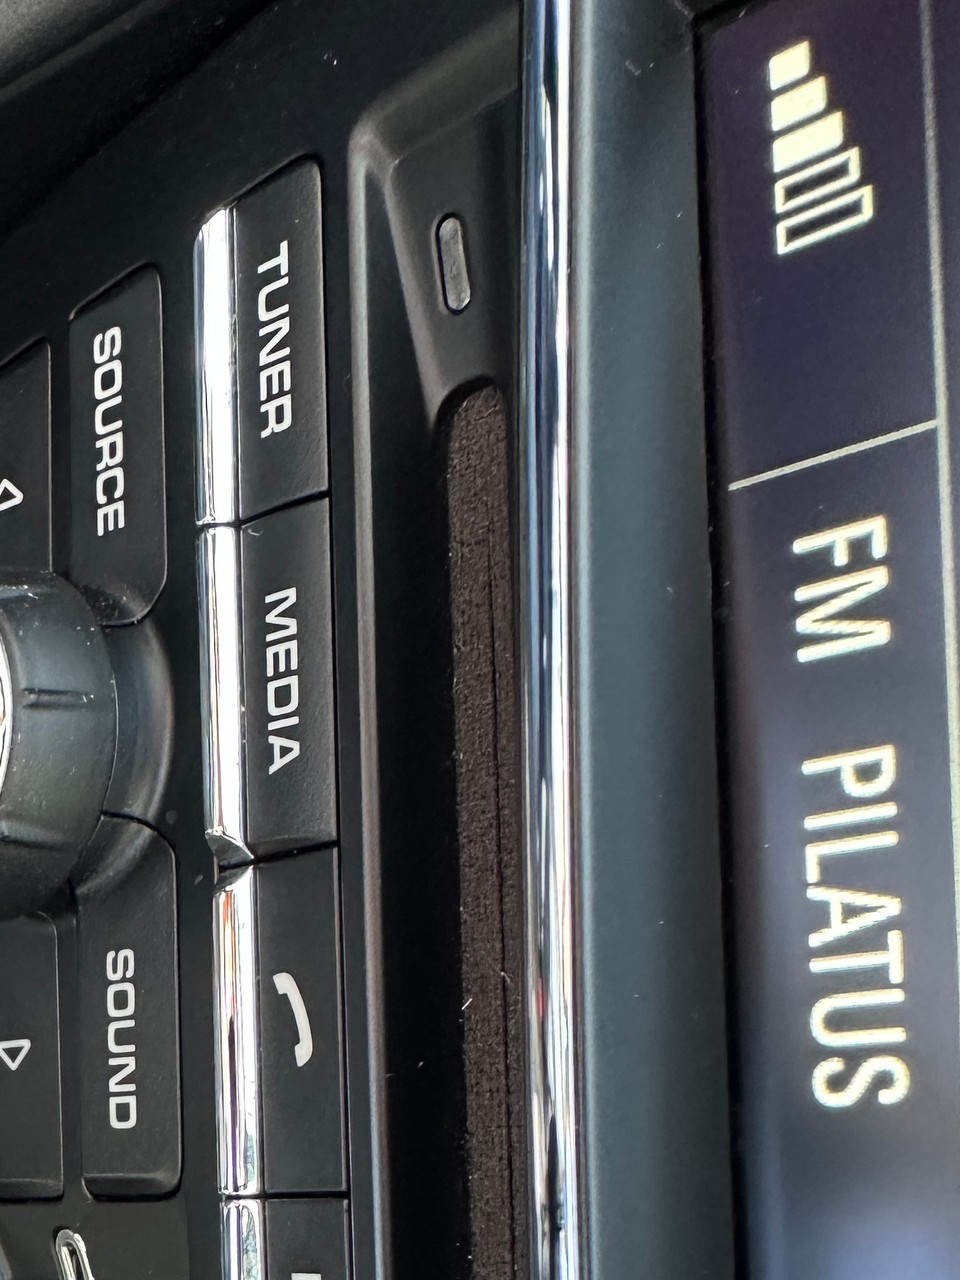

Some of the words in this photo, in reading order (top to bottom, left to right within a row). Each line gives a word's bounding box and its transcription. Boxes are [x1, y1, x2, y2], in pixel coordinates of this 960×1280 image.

[93, 325, 126, 537] SOURCE
[256, 240, 292, 440] TUNER
[264, 586, 301, 776] MEDIA
[792, 515, 892, 665] FM
[801, 743, 912, 1110] PILATUS
[106, 948, 138, 1131] SOUND
